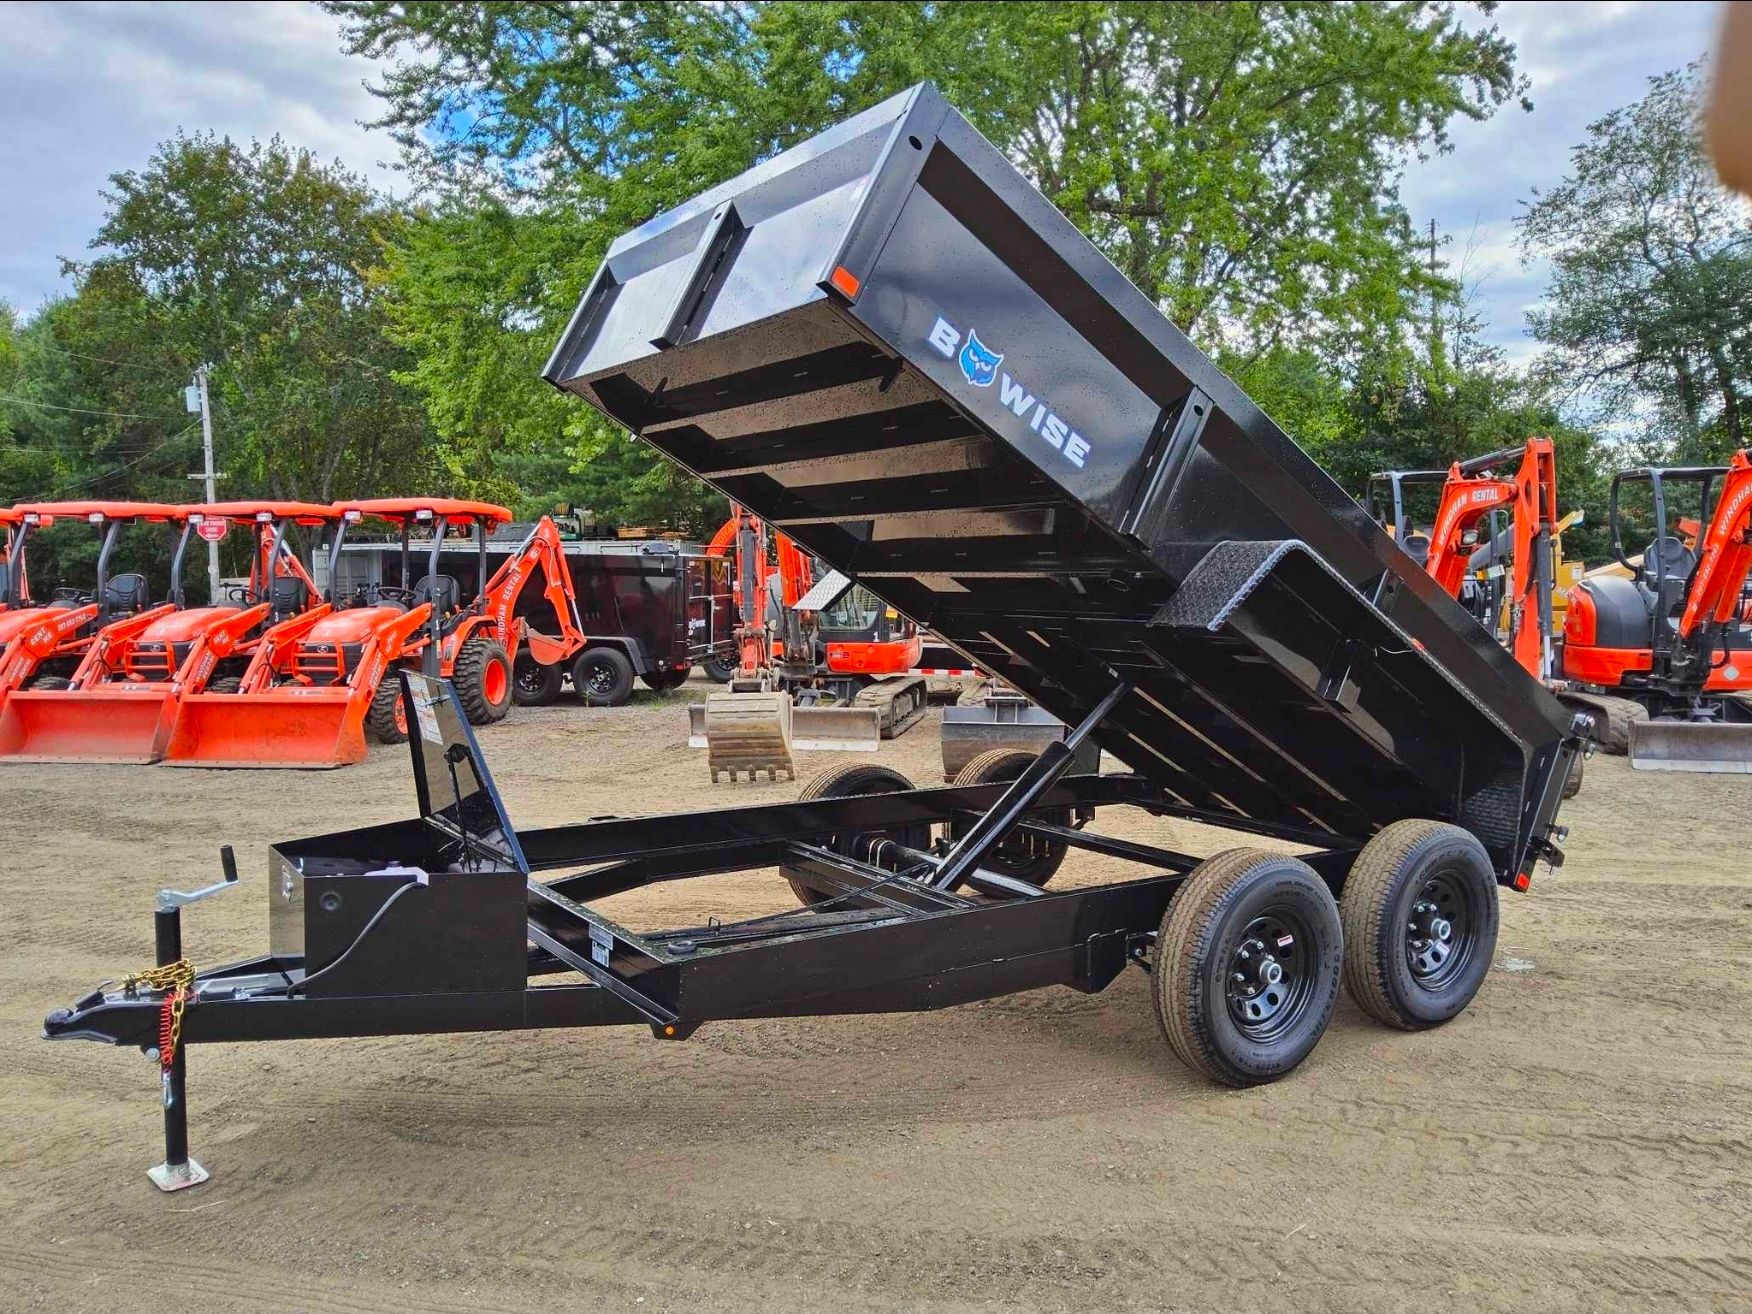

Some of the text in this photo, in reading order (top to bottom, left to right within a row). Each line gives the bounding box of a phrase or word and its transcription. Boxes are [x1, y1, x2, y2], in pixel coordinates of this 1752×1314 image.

[1000, 372, 1091, 468] WISE
[1472, 488, 1499, 502] RENTAL
[1720, 481, 1752, 535] WINDHA
[502, 573, 522, 601] RENTAL
[873, 631, 880, 642] 1
